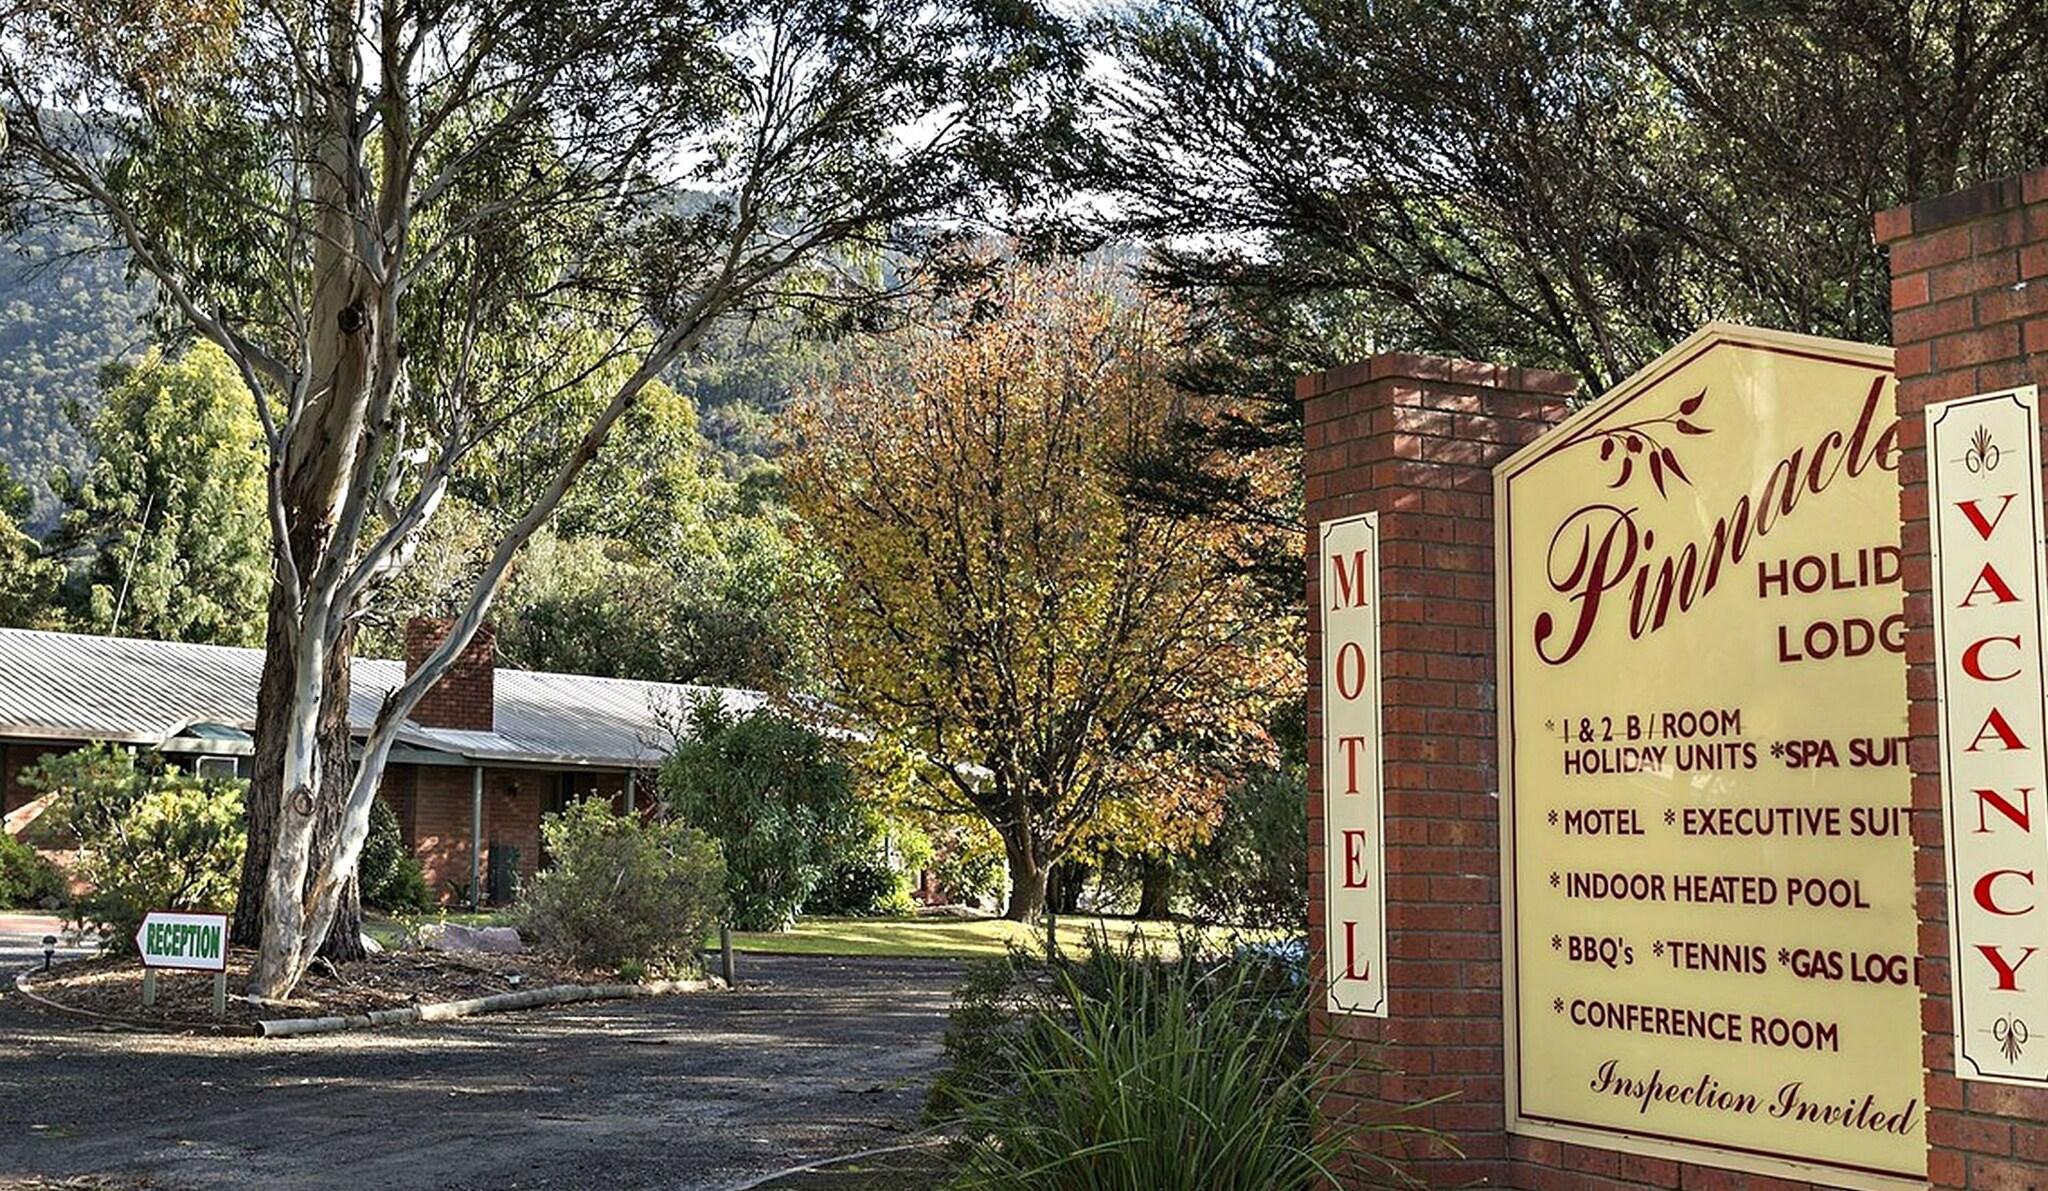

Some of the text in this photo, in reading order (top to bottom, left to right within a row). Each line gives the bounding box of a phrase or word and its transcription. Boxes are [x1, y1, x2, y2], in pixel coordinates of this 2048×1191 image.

[1534, 375, 1900, 665] Pinnacle
[1578, 717, 1595, 743] &
[1601, 716, 1613, 742] 2
[1953, 494, 2039, 992] VACANCY
[1331, 549, 1370, 981] MOTEL
[1564, 742, 1758, 774] HOLIDAY UNITS
[1564, 810, 1645, 835] MOTEL
[1683, 808, 1841, 836] EXECUTIVE
[1566, 873, 1870, 909] INDOOR HEATED POOL
[147, 923, 220, 959] RECEPTION
[1568, 937, 1634, 966] BBQ's
[1667, 942, 1767, 974] TENNIS
[1851, 952, 1908, 985] LOG
[1570, 1000, 1839, 1052] CONFERENCE ROOM
[1590, 1059, 1919, 1136] Inspection Invited
